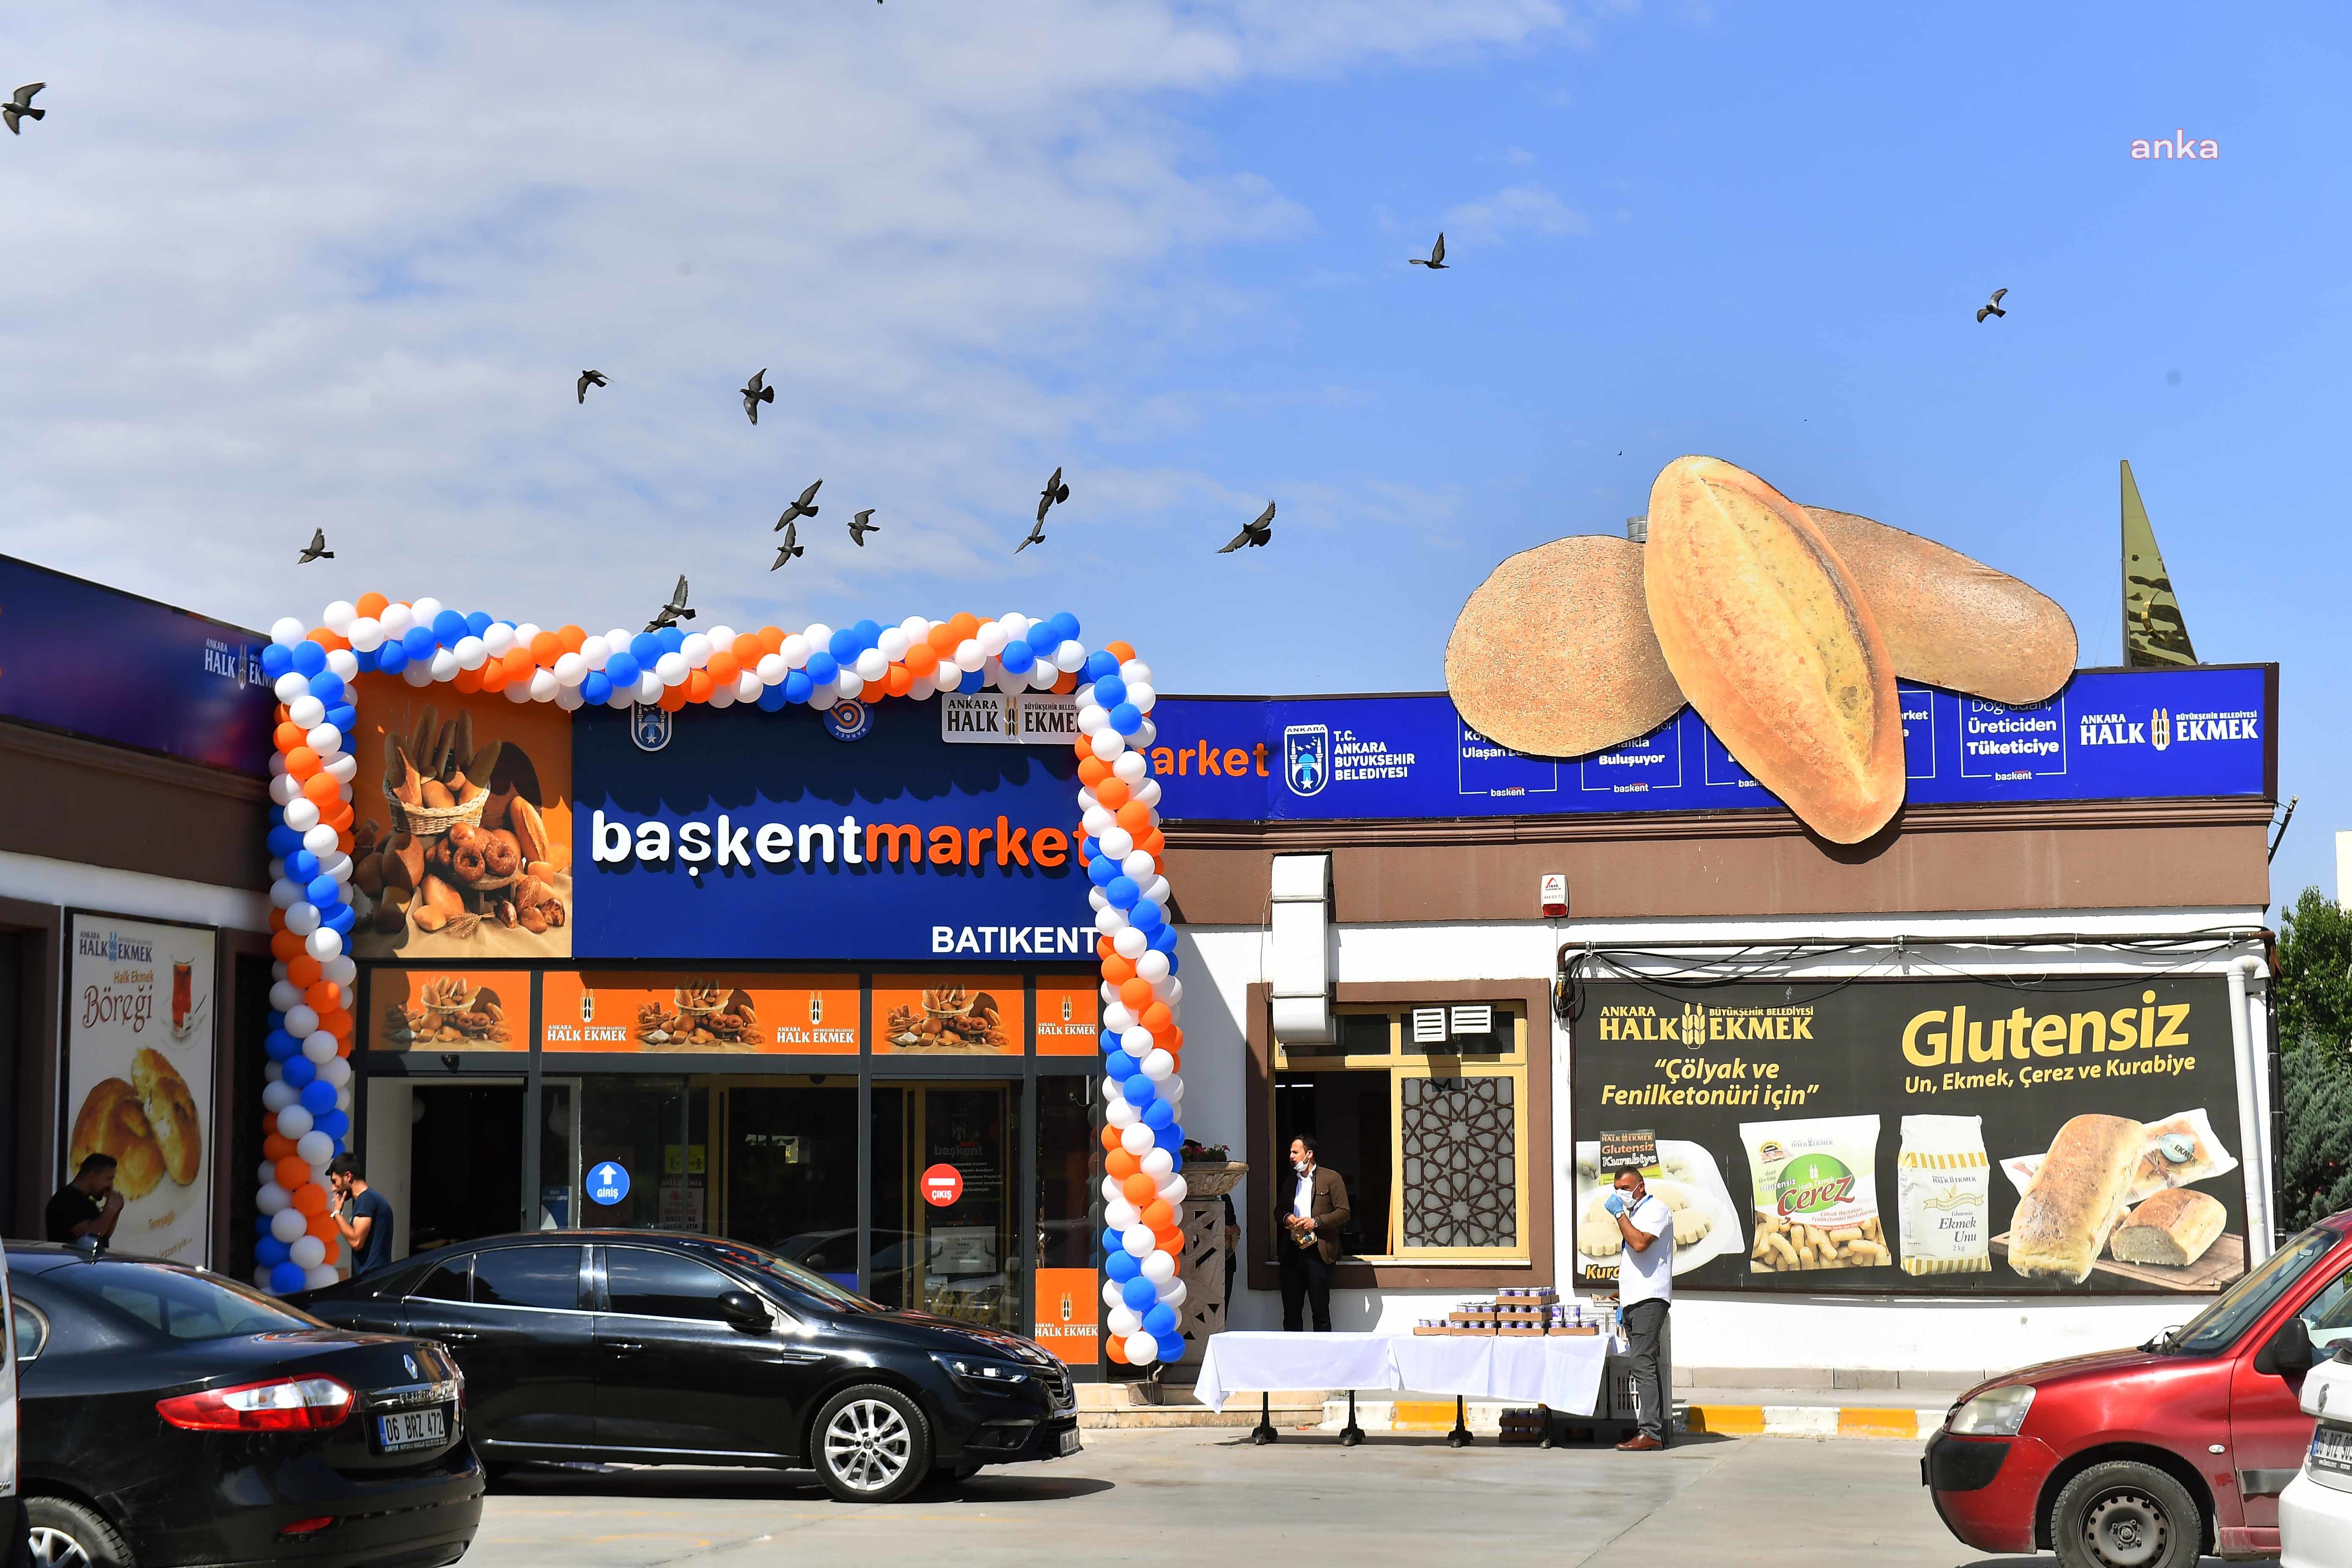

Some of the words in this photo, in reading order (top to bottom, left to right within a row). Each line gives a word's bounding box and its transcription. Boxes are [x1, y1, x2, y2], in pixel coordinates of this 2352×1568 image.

[206, 637, 228, 653] ANKARA
[204, 648, 236, 678] HALK
[249, 662, 276, 689] EKM
[948, 700, 998, 709] ANKARA
[1024, 702, 1057, 711] BÜYÜKŞEHİR
[947, 710, 999, 732] HALK
[2081, 714, 2126, 724] ANKARA
[2176, 713, 2218, 721] BÜYÜKŞEHİR
[2220, 710, 2257, 719] BELEDİYESİ
[1968, 717, 2057, 734] Üreticiden
[2080, 723, 2145, 745] HALK
[2177, 719, 2259, 741] EKMEK
[1333, 730, 1356, 741] T.C.
[1334, 741, 1387, 754] ANKARA
[1463, 747, 1505, 760] Ulaşan
[1967, 738, 2059, 756] Tüketiciye
[1137, 740, 1269, 777] arket
[1599, 754, 1665, 767] Buluşuyor
[932, 926, 1100, 953] BATIKENT
[80, 938, 108, 957] HALK
[118, 943, 152, 963] EKMEK
[114, 971, 129, 983] Halk
[131, 970, 154, 983] Ekmek
[83, 985, 152, 1033] Böreği
[1601, 1006, 1656, 1016] ANKARA
[1709, 1007, 1764, 1017] BÜYÜKŞEHİR
[1767, 1006, 1814, 1016] BELEDİYESİ
[547, 1030, 582, 1041] HALK
[584, 1030, 626, 1041] EKMEK
[1038, 1026, 1063, 1034] HALK
[1065, 1026, 1095, 1034] EKMEK
[1600, 1018, 1680, 1040] HALK
[1709, 1017, 1814, 1040] EKMEK
[1902, 990, 2190, 1067] Glutensiz
[777, 1032, 810, 1043] HALK
[813, 1032, 854, 1043] EKMEK
[1753, 1063, 1780, 1078] ve
[1905, 1076, 1937, 1094] Un,
[1943, 1069, 2014, 1091] Ekmek,
[2019, 1065, 2074, 1088] Çerez
[2081, 1065, 2101, 1080] ve
[2106, 1054, 2195, 1076] Kurabiye
[1601, 1084, 1760, 1105] Fenilketonüri
[1601, 1142, 1654, 1154] Glutensiz
[2174, 1144, 2197, 1165] EKMEK
[597, 1183, 618, 1199] GİRİŞ
[1799, 1183, 1813, 1192] Halk
[1814, 1176, 1835, 1186] Ekmek
[932, 1190, 952, 1200] ÇIKIŞ
[1777, 1174, 1855, 1225] Çerez
[1938, 1217, 1976, 1229] Ekmek
[1955, 1231, 1976, 1242] Unu
[1586, 1265, 1619, 1279] Kura
[1035, 1327, 1062, 1337] HALK
[1064, 1327, 1098, 1336] EKMEK
[386, 1417, 400, 1442] 06
[404, 1413, 424, 1439] BRZ
[427, 1412, 444, 1436] 472
